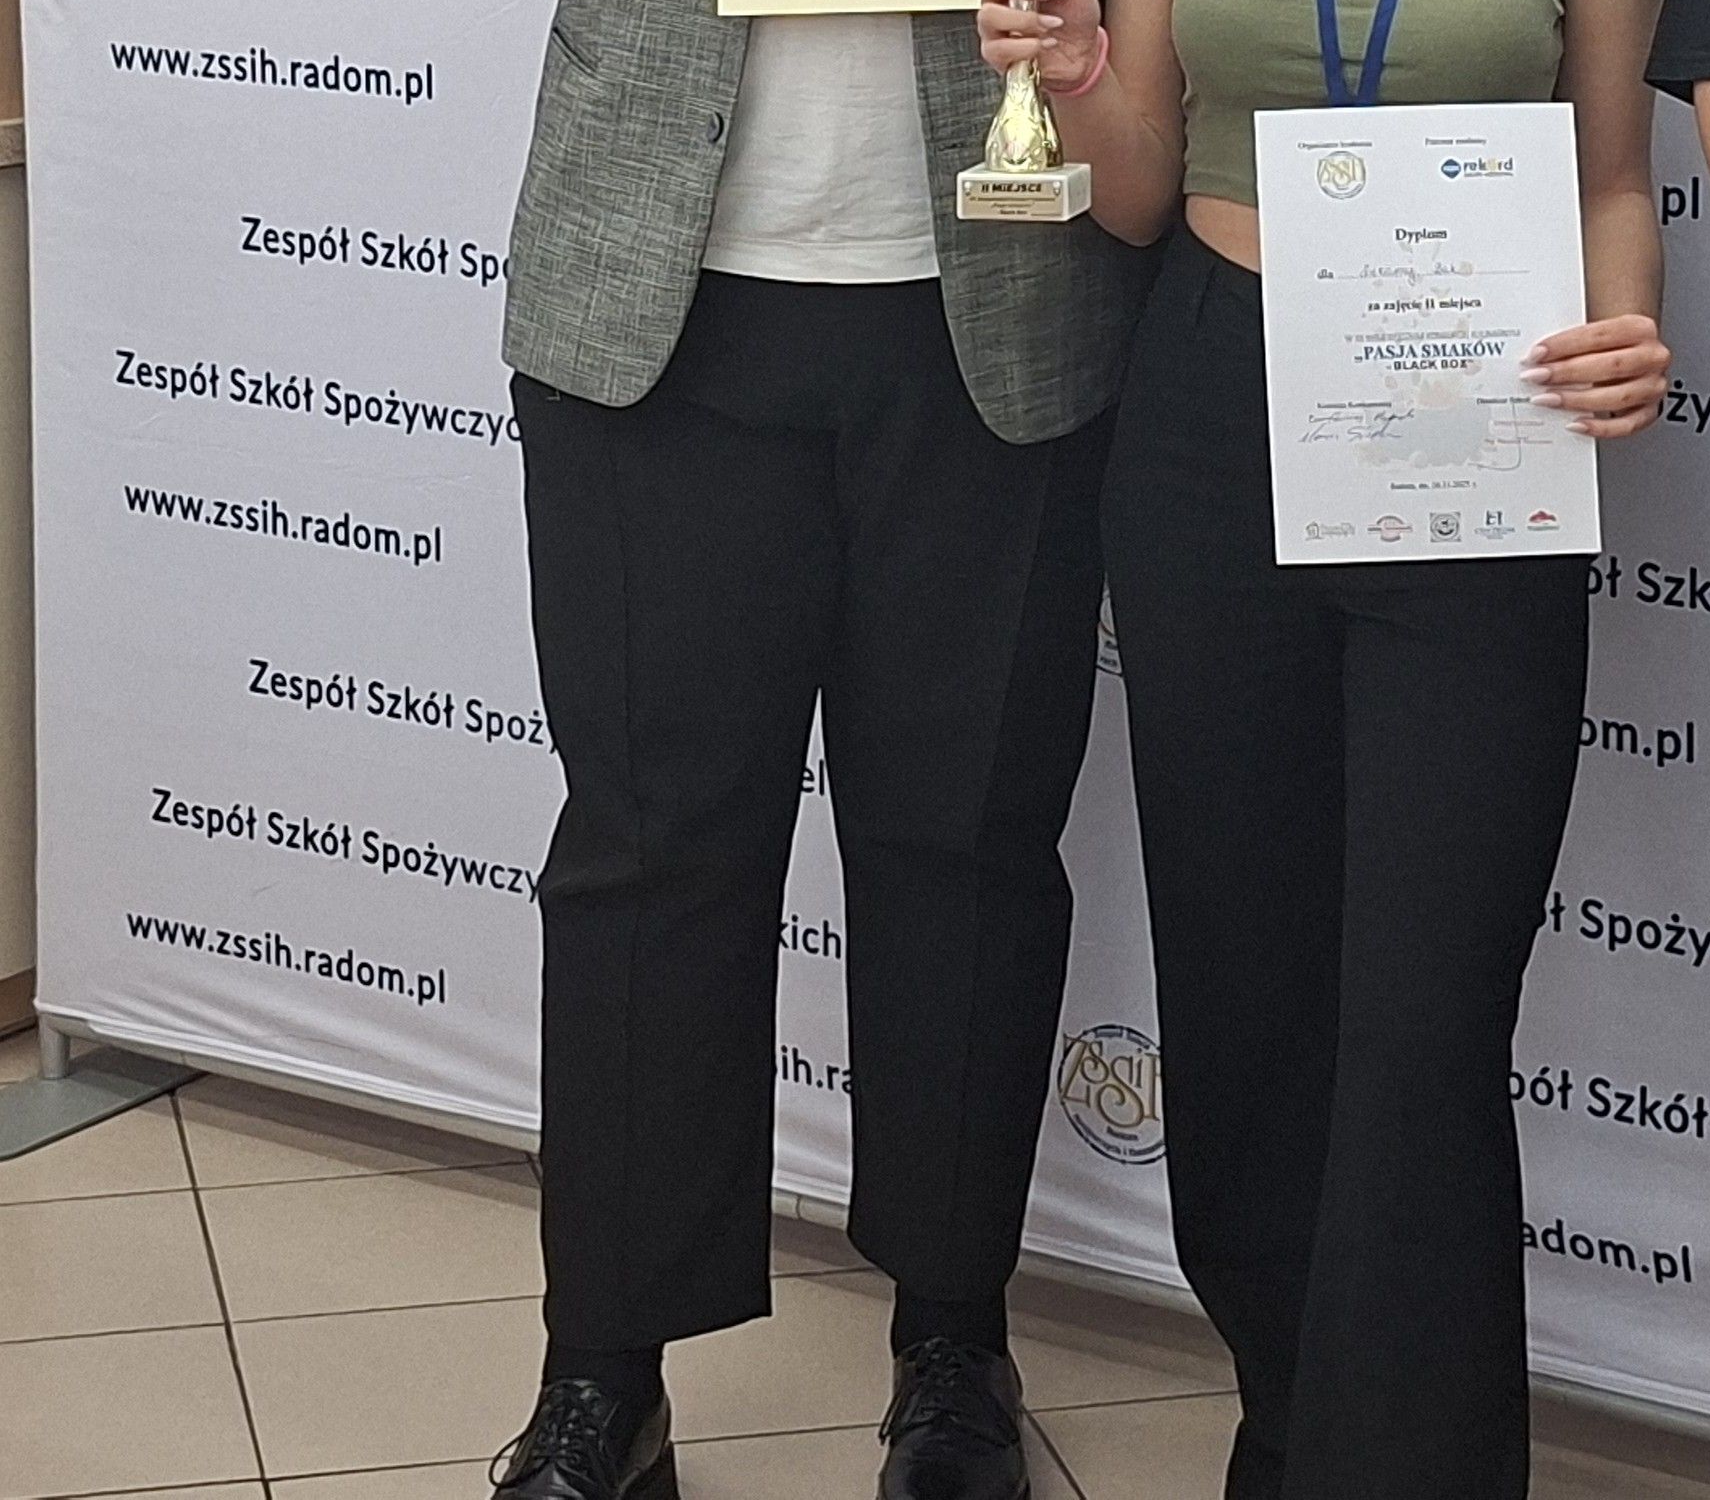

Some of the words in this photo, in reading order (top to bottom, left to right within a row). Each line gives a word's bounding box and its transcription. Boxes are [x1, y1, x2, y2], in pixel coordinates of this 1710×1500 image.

[111, 43, 433, 106] www.zssih.radom.pl
[241, 216, 350, 265] Zespół
[361, 231, 449, 275] Szkół
[1395, 227, 1448, 243] Dyplom
[1421, 340, 1505, 358] SMAKÓW
[116, 349, 220, 399] Zespół
[229, 367, 314, 413] Szkół
[323, 383, 521, 446] Spożywczyc
[124, 485, 441, 567] www.zssih.radom.pl
[249, 659, 357, 711] Zespół
[367, 680, 455, 729] Szkół
[151, 787, 257, 840] Zespół
[267, 811, 352, 860] Szkół
[361, 831, 538, 903] Spożywczy
[127, 913, 445, 1006] www.zssih.radom.pl
[1586, 1077, 1709, 1139] Szkół
